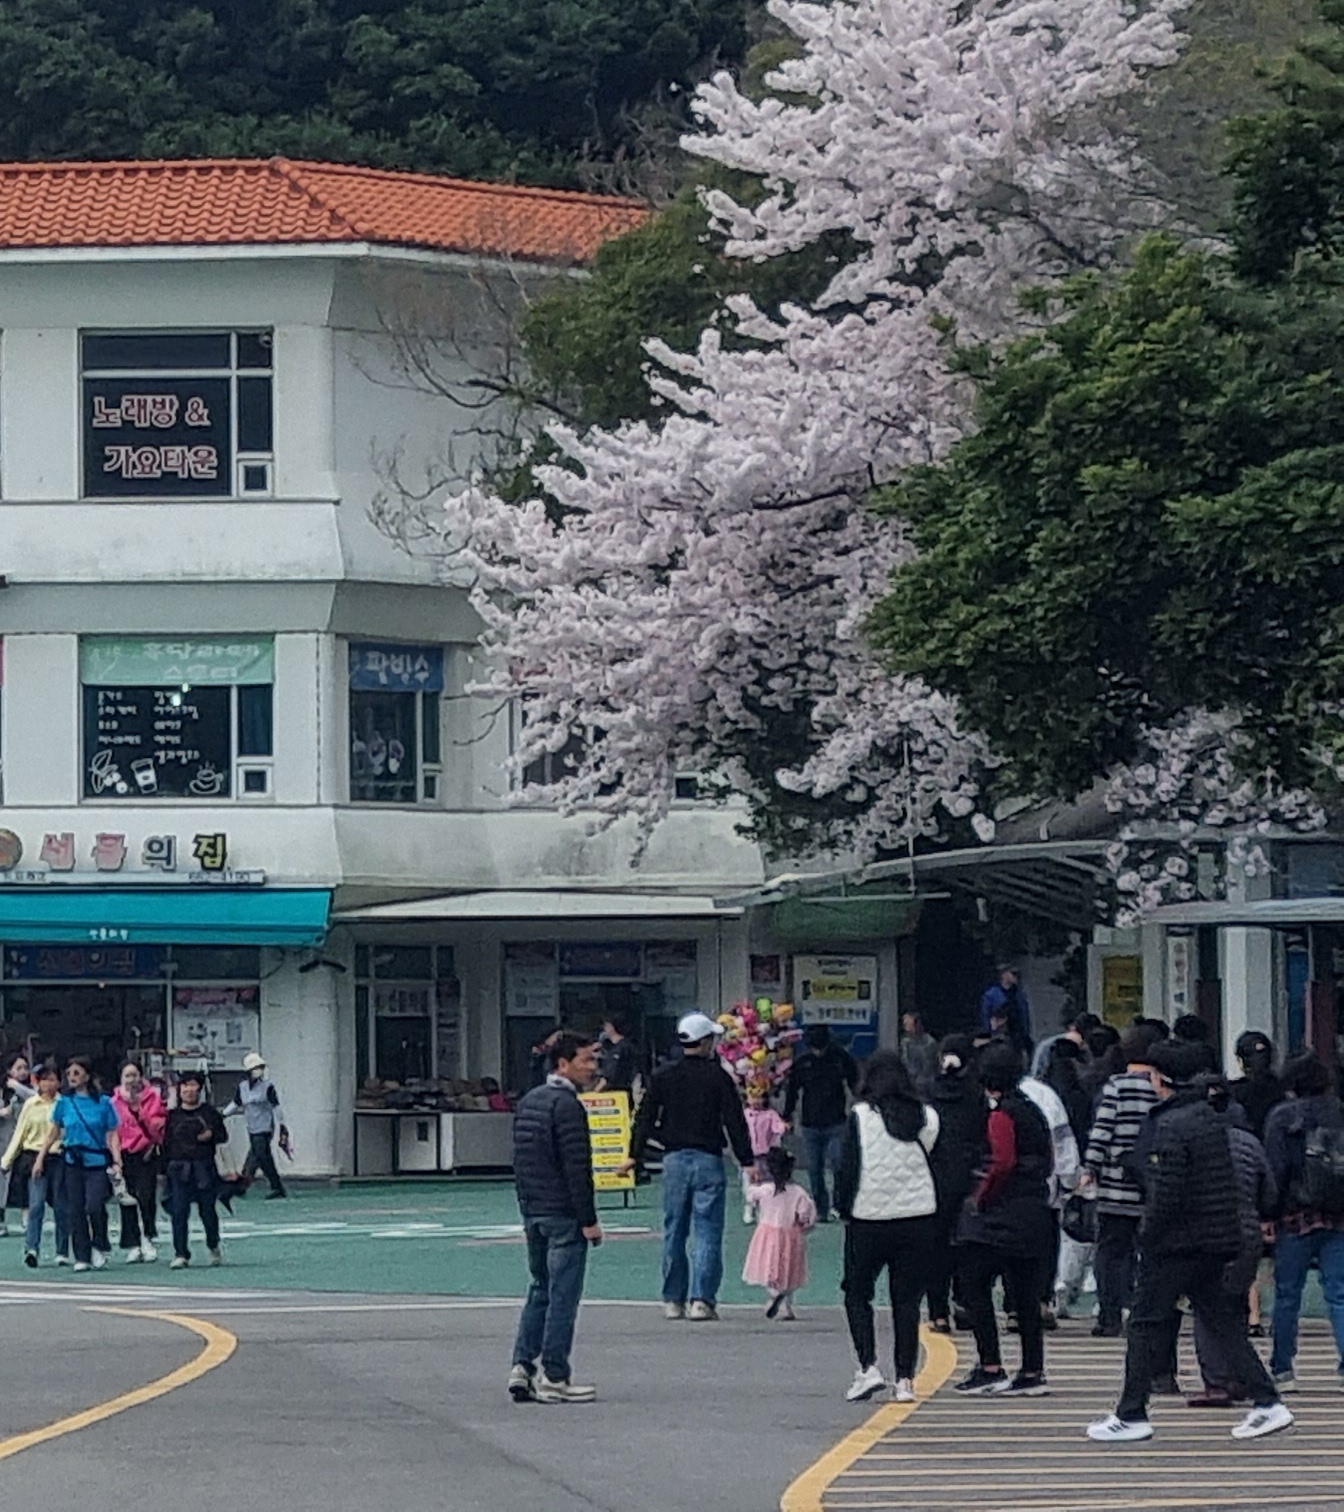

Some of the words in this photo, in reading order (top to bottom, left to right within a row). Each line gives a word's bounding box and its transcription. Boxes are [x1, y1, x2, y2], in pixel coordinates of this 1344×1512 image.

[92, 395, 179, 428] 노래방
[184, 396, 212, 426] &
[103, 446, 218, 478] 가요타운
